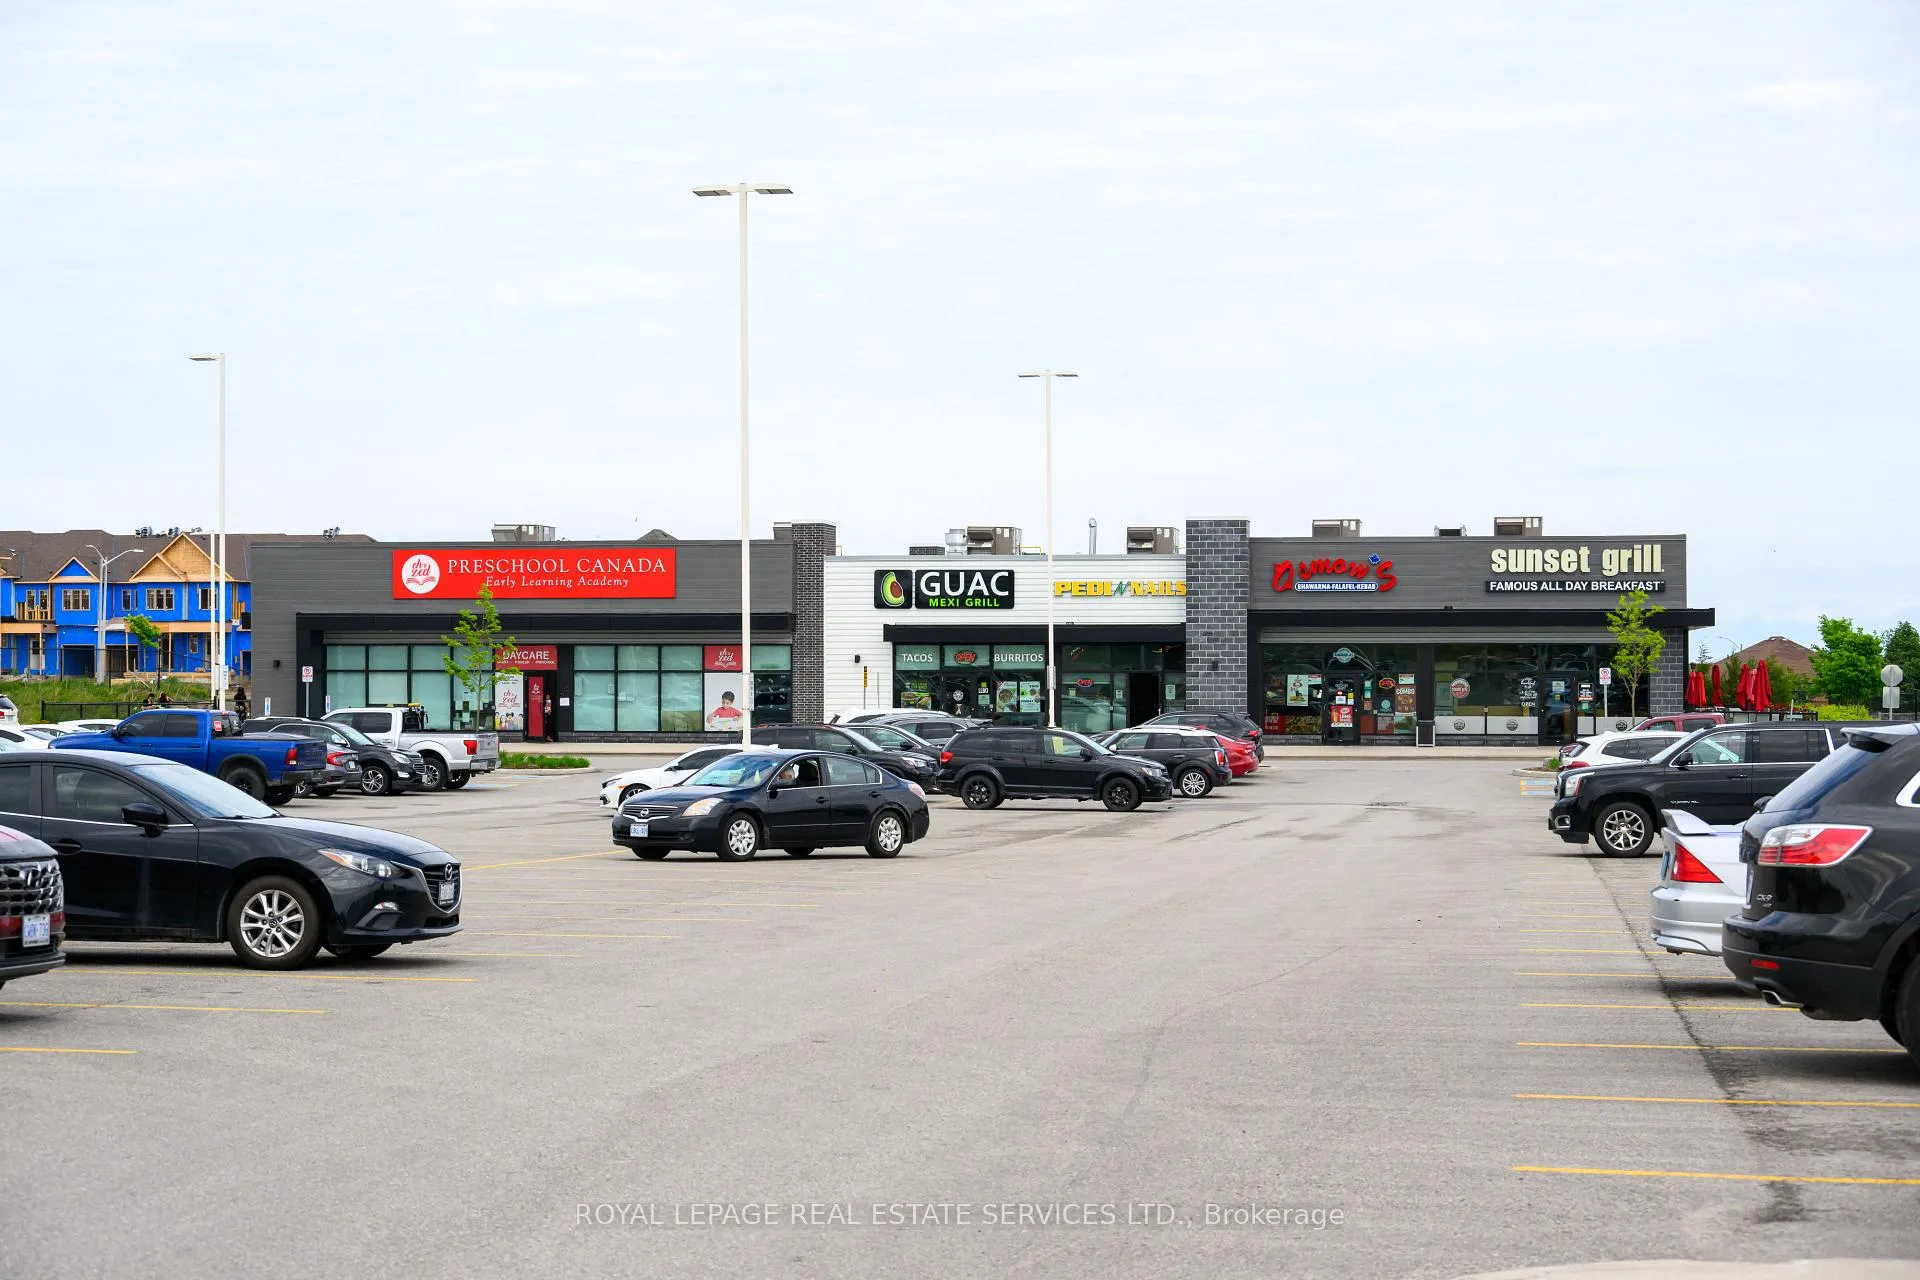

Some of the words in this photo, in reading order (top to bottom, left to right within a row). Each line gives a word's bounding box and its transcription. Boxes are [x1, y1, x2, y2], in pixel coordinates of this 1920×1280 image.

[1491, 546, 1591, 573] sunset
[447, 559, 569, 574] PRESCHOOL
[576, 558, 666, 573] CANADA
[485, 576, 516, 588] Early
[521, 576, 573, 588] Learning
[577, 576, 629, 588] Academy
[920, 571, 1009, 596] GUAC
[1489, 581, 1538, 591] FAMOUS
[1540, 581, 1563, 591] ALL
[1565, 581, 1589, 591] DAY
[1590, 581, 1661, 591] BREAKFAST
[1054, 581, 1112, 596] PEDI
[1130, 581, 1187, 596] NAILS
[928, 598, 960, 607] MEXI
[965, 598, 1000, 607] GRILL
[503, 651, 550, 660] DAYCARE
[902, 653, 933, 662] TACOS
[994, 653, 1044, 662] BURRITOS
